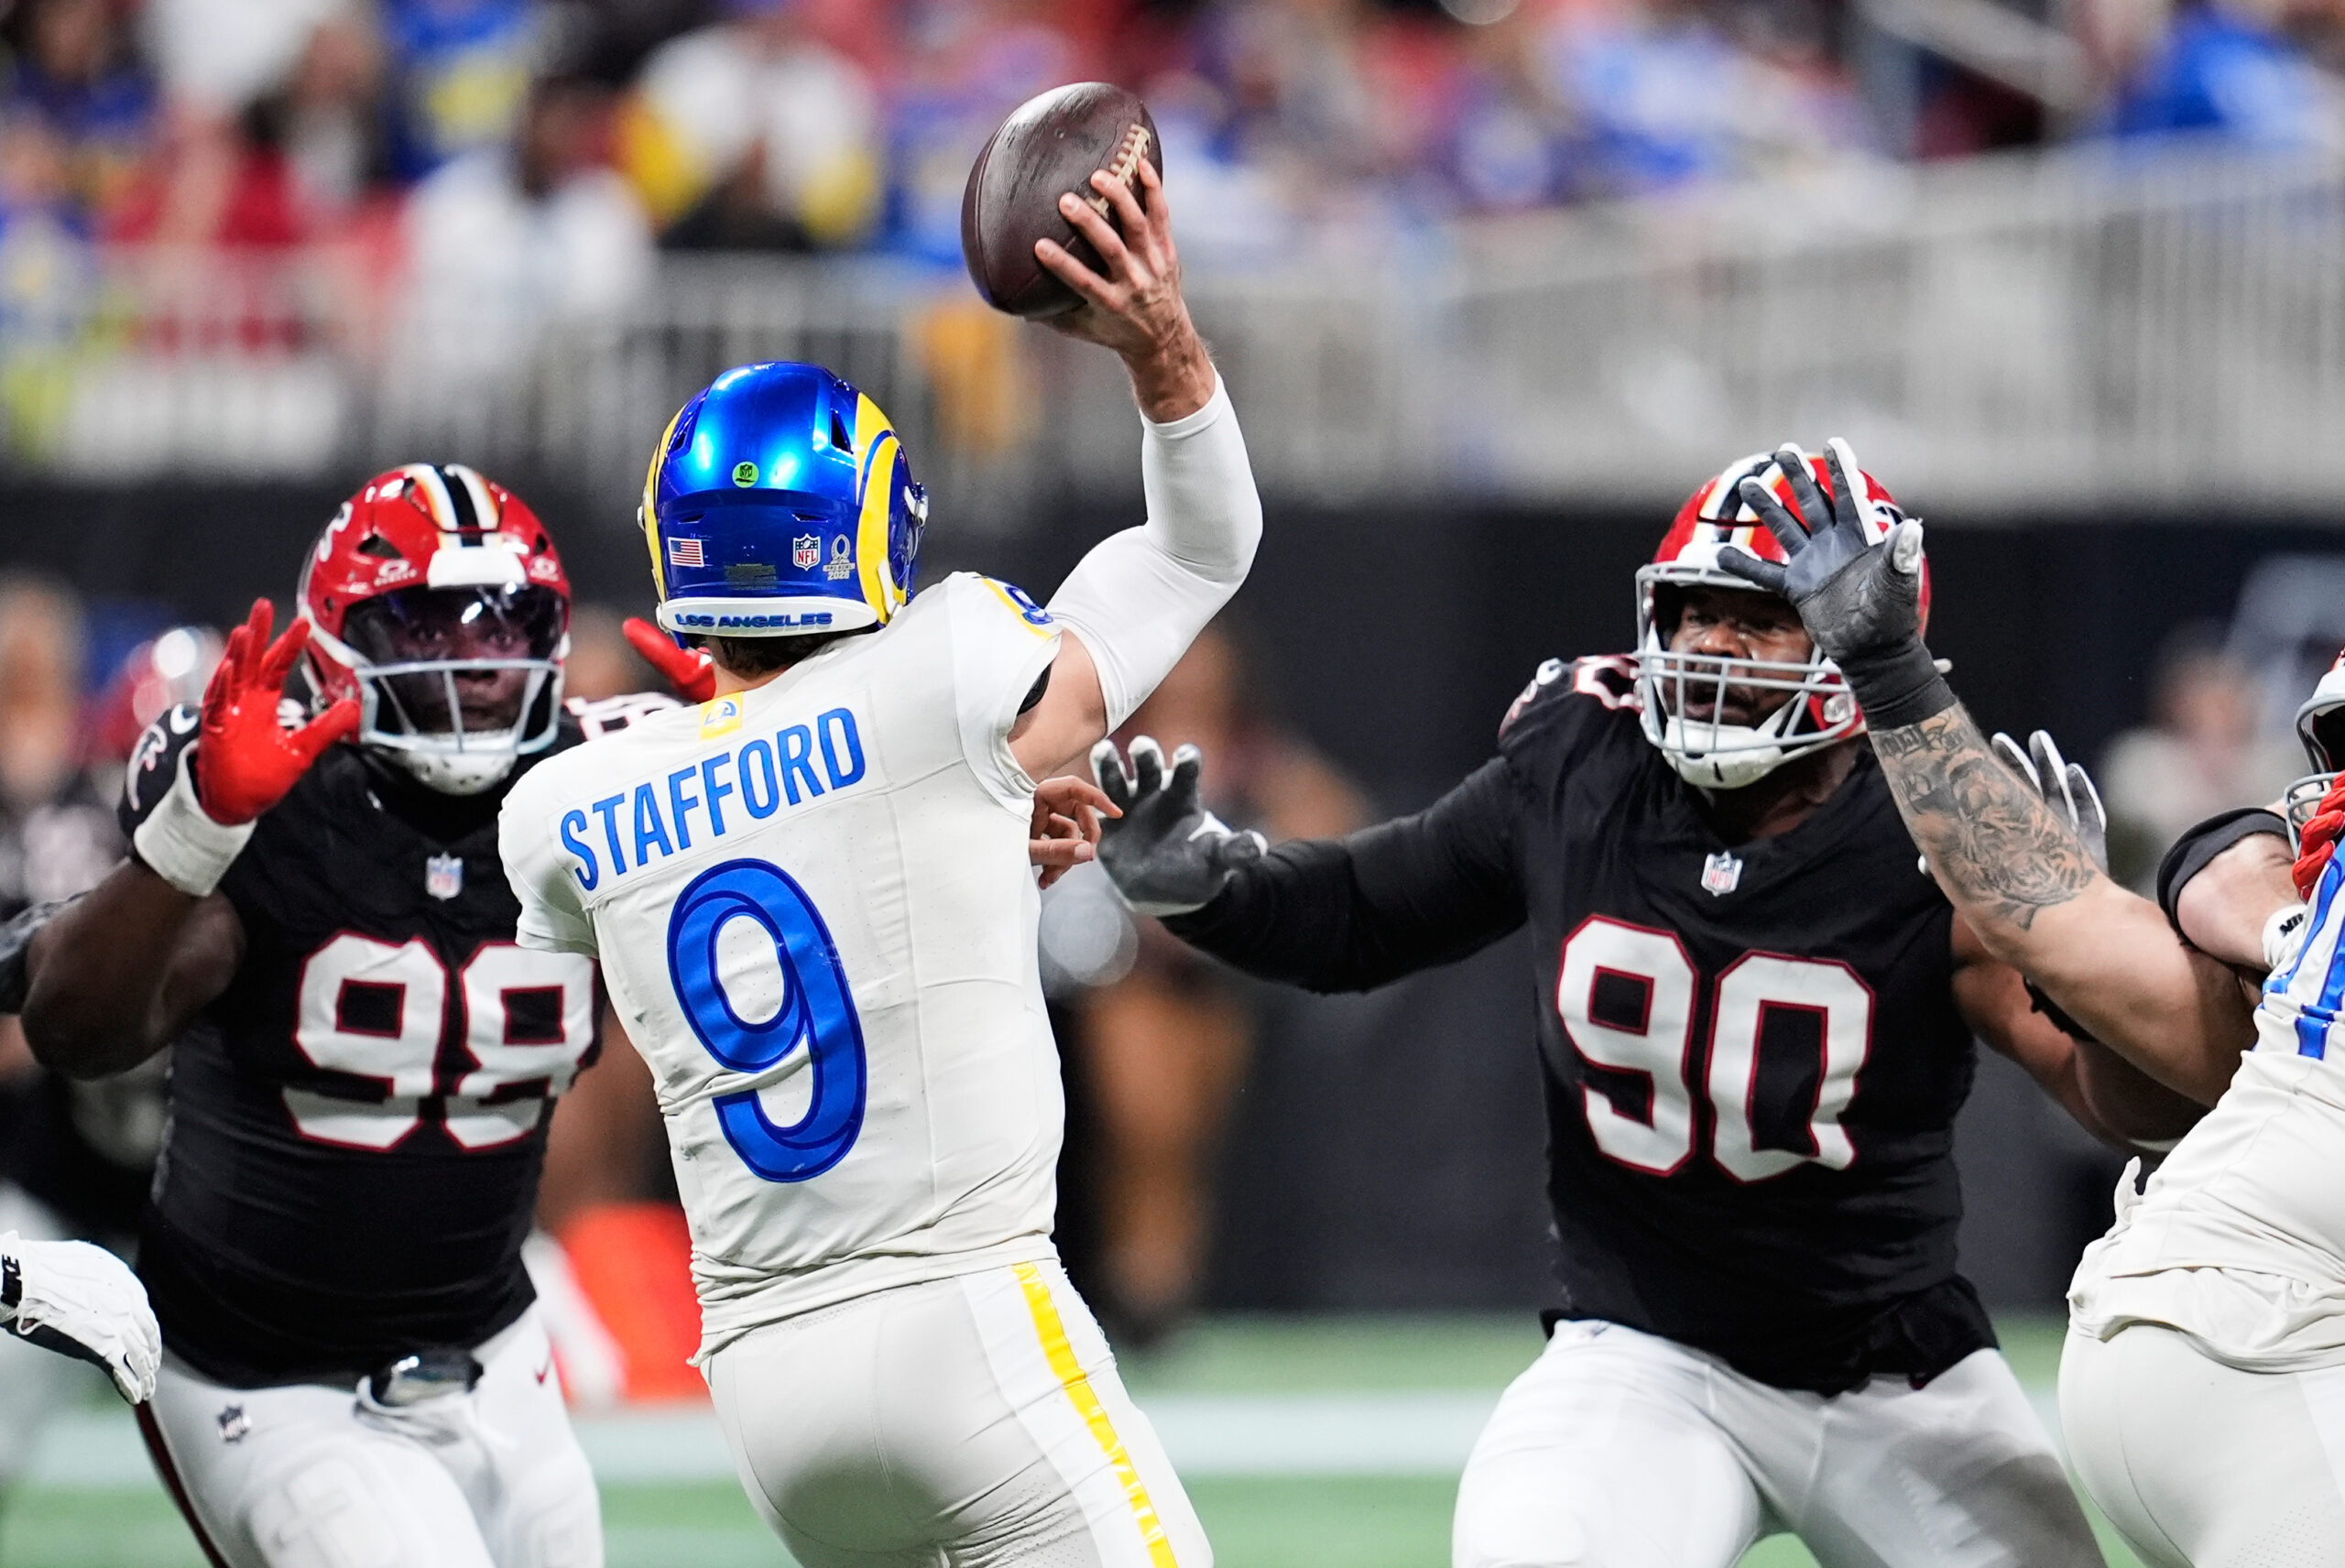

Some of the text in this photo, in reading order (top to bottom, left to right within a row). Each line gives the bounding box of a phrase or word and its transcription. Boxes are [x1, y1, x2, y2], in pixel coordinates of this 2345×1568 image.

[675, 612, 833, 628] LOS ANGELES
[797, 550, 817, 564] NFL
[560, 707, 867, 892] STAFFORD
[281, 929, 599, 1154] 98
[667, 857, 867, 1183] 9
[1555, 913, 1876, 1186] 90
